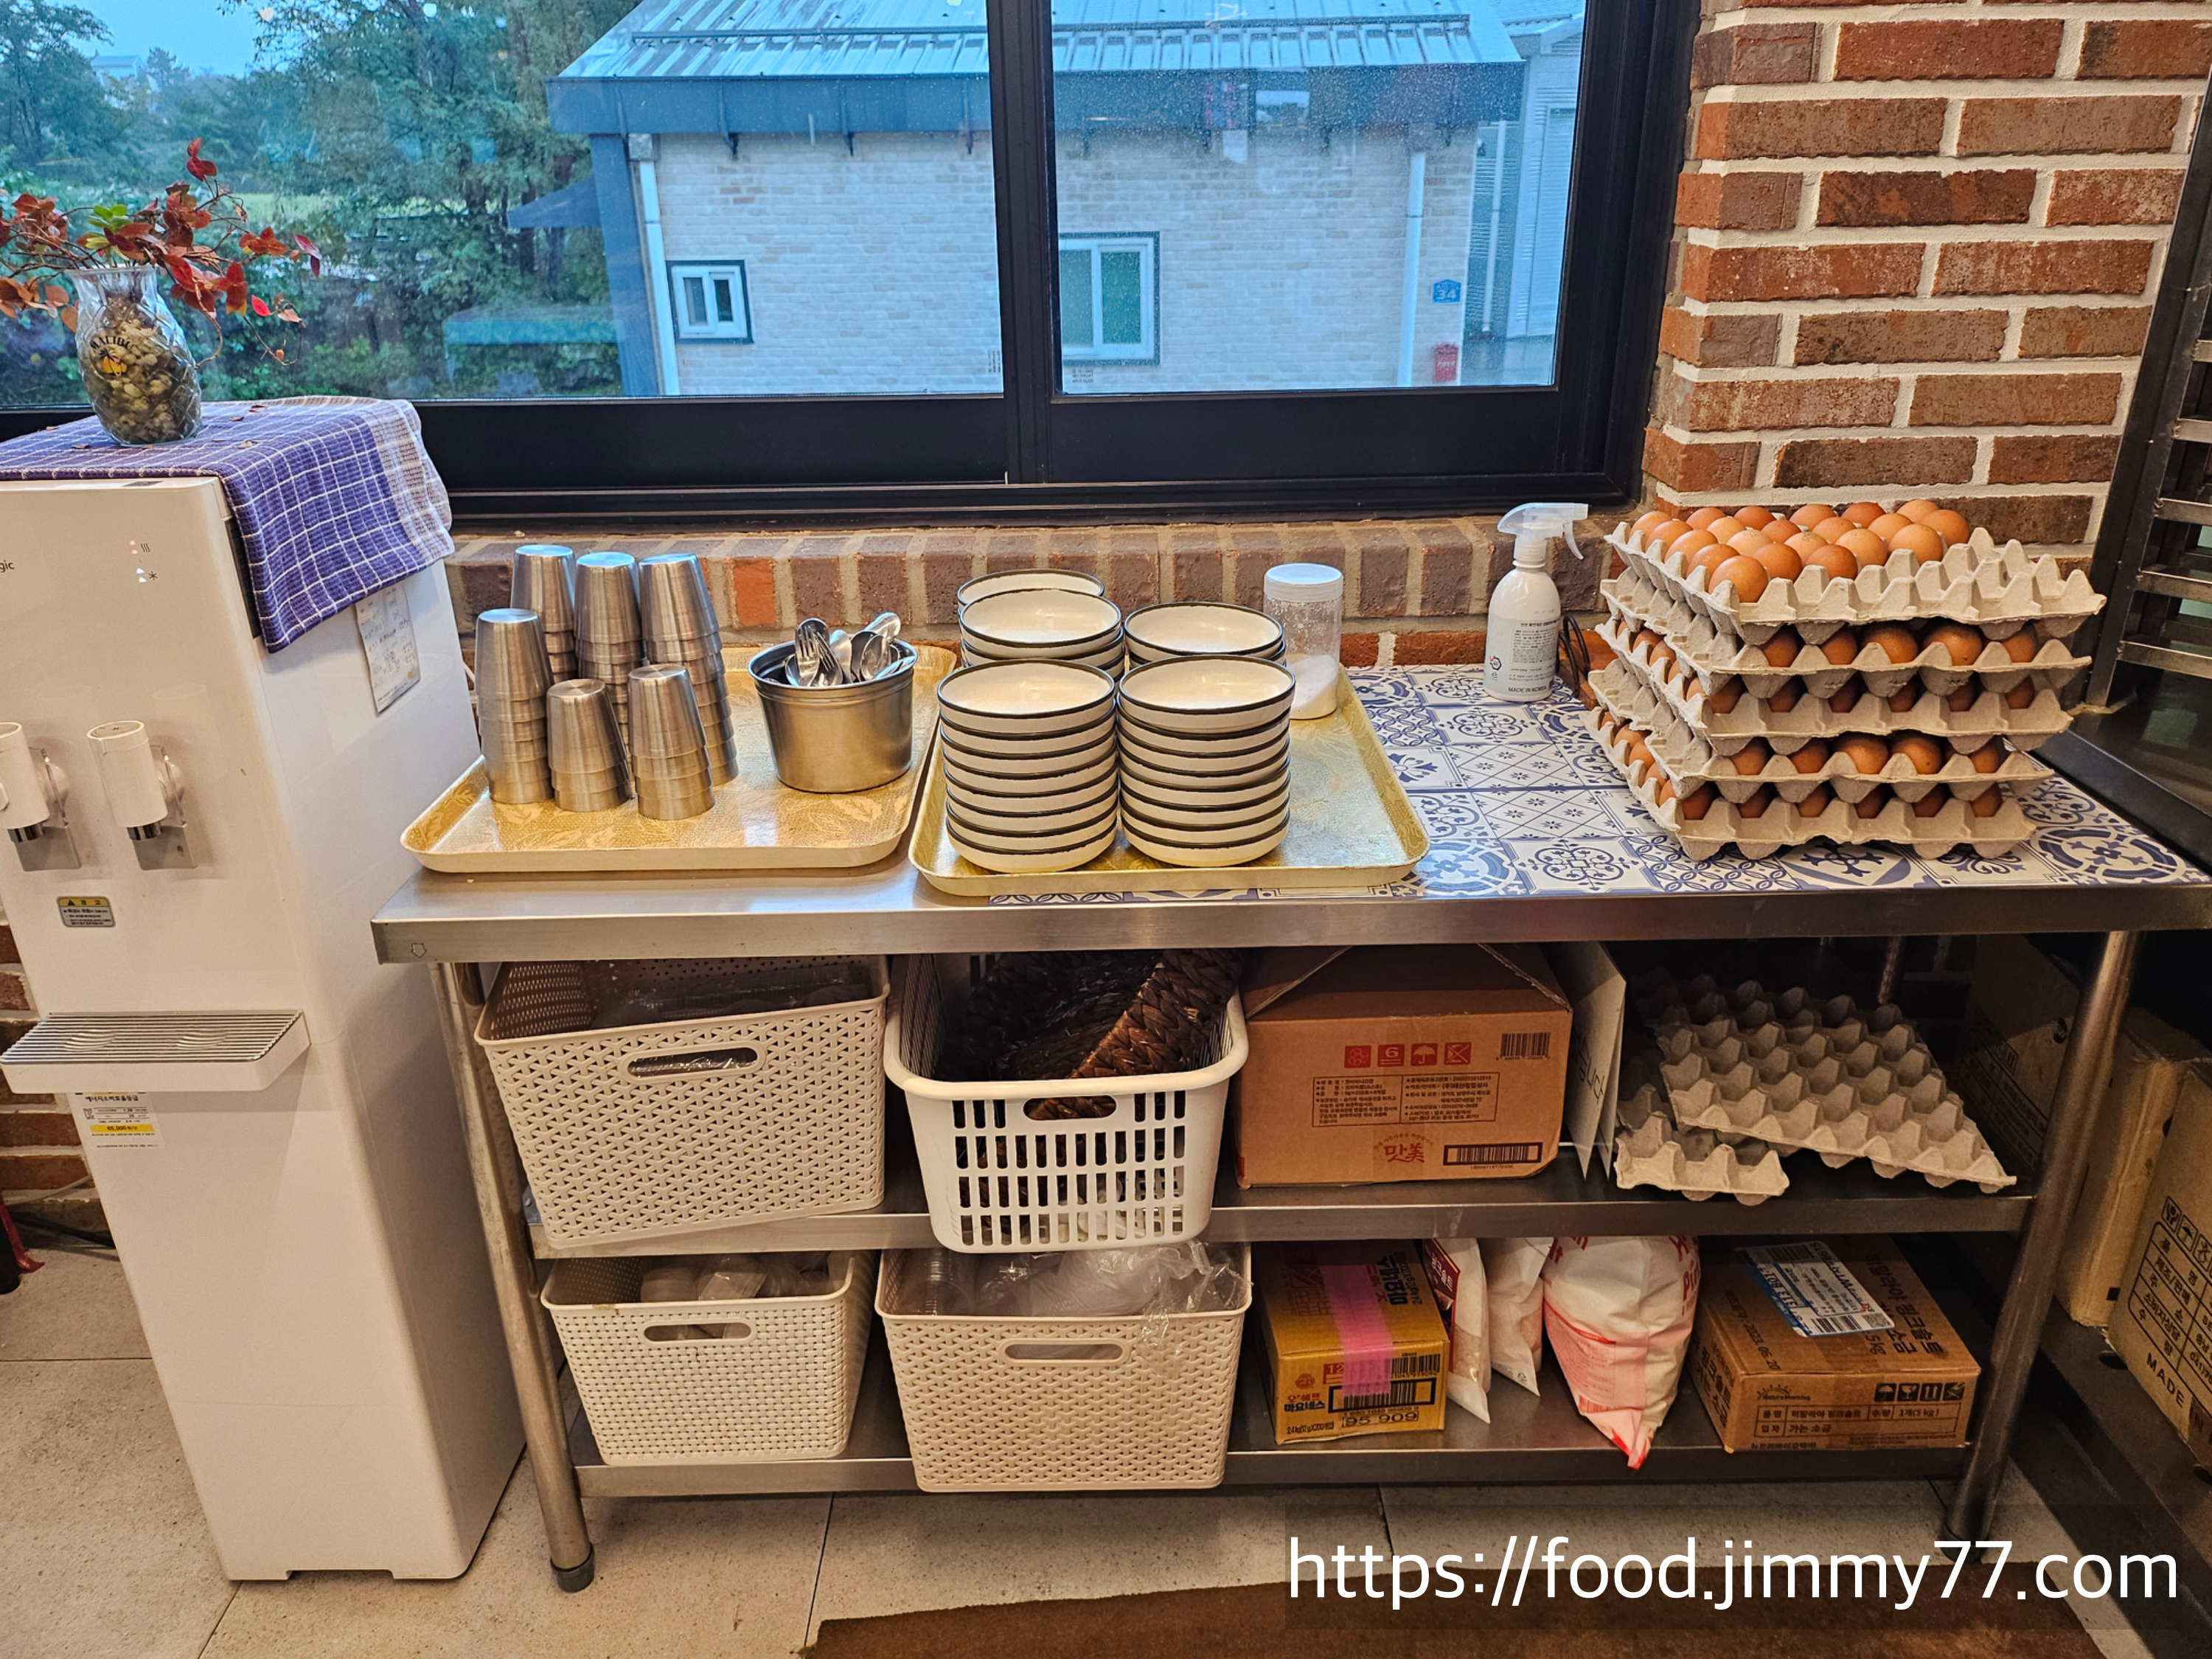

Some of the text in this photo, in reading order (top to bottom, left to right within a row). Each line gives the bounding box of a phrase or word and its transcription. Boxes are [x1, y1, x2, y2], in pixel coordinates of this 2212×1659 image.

[1437, 289, 1457, 299] 34
[2146, 1352, 2185, 1408] MADE
[1284, 1400, 1326, 1413] 마요네스
[1345, 1411, 1417, 1427] 95 909
